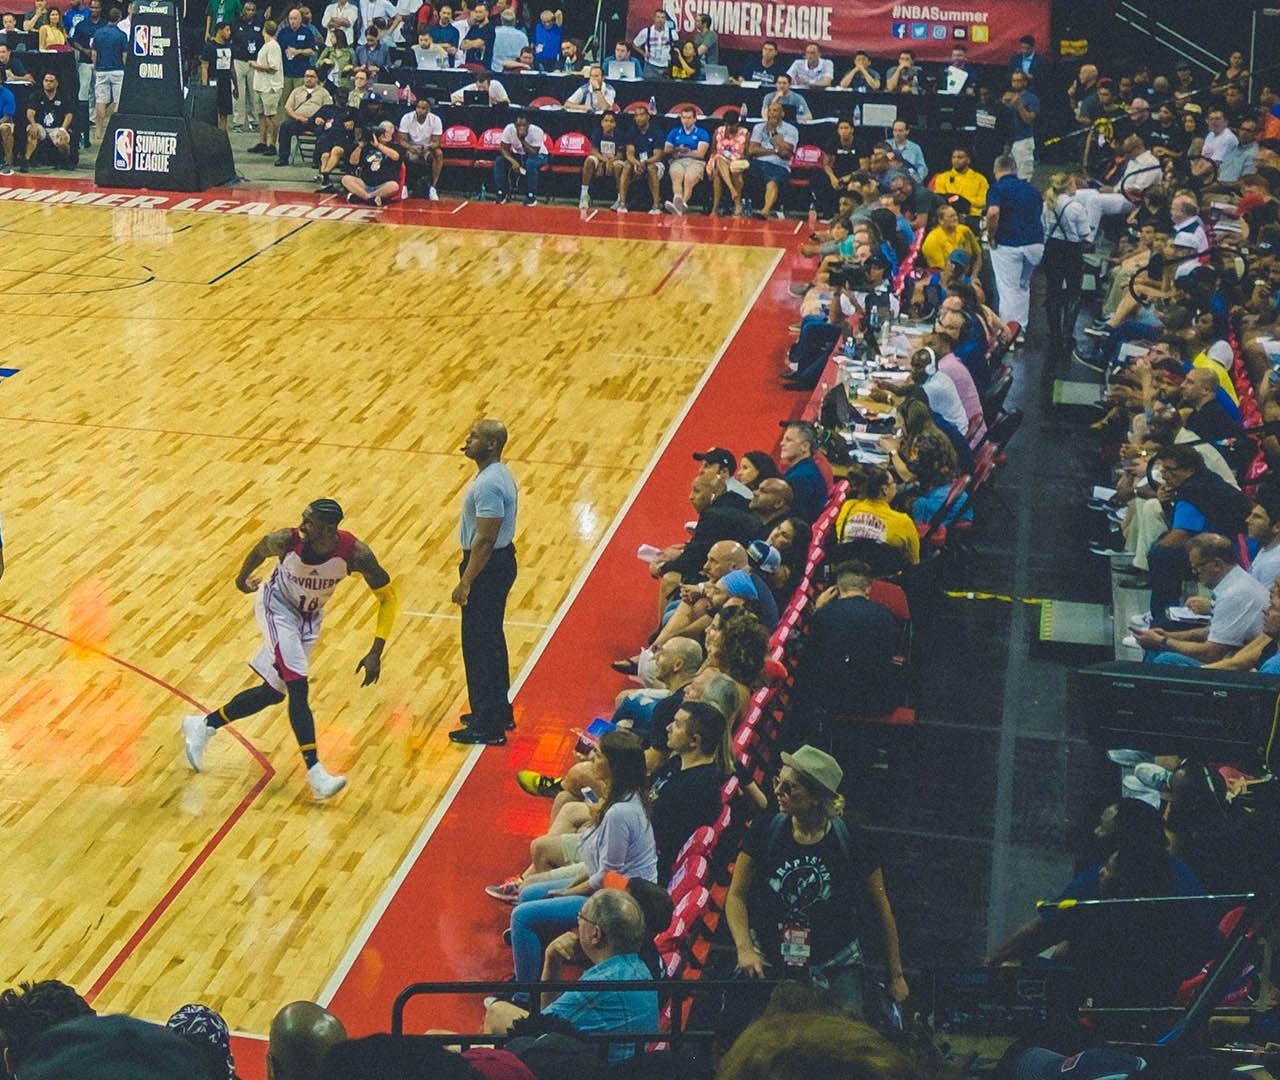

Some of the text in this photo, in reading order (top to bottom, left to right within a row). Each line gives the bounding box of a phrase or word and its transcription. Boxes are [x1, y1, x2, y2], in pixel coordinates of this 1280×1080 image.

[766, 5, 832, 42] LEAGUE
[891, 7, 989, 23] #NBASummer
[139, 63, 164, 80] @NBA
[136, 135, 177, 156] SUMMER
[135, 154, 170, 173] LEAGUE
[172, 197, 384, 224] LEAGUE
